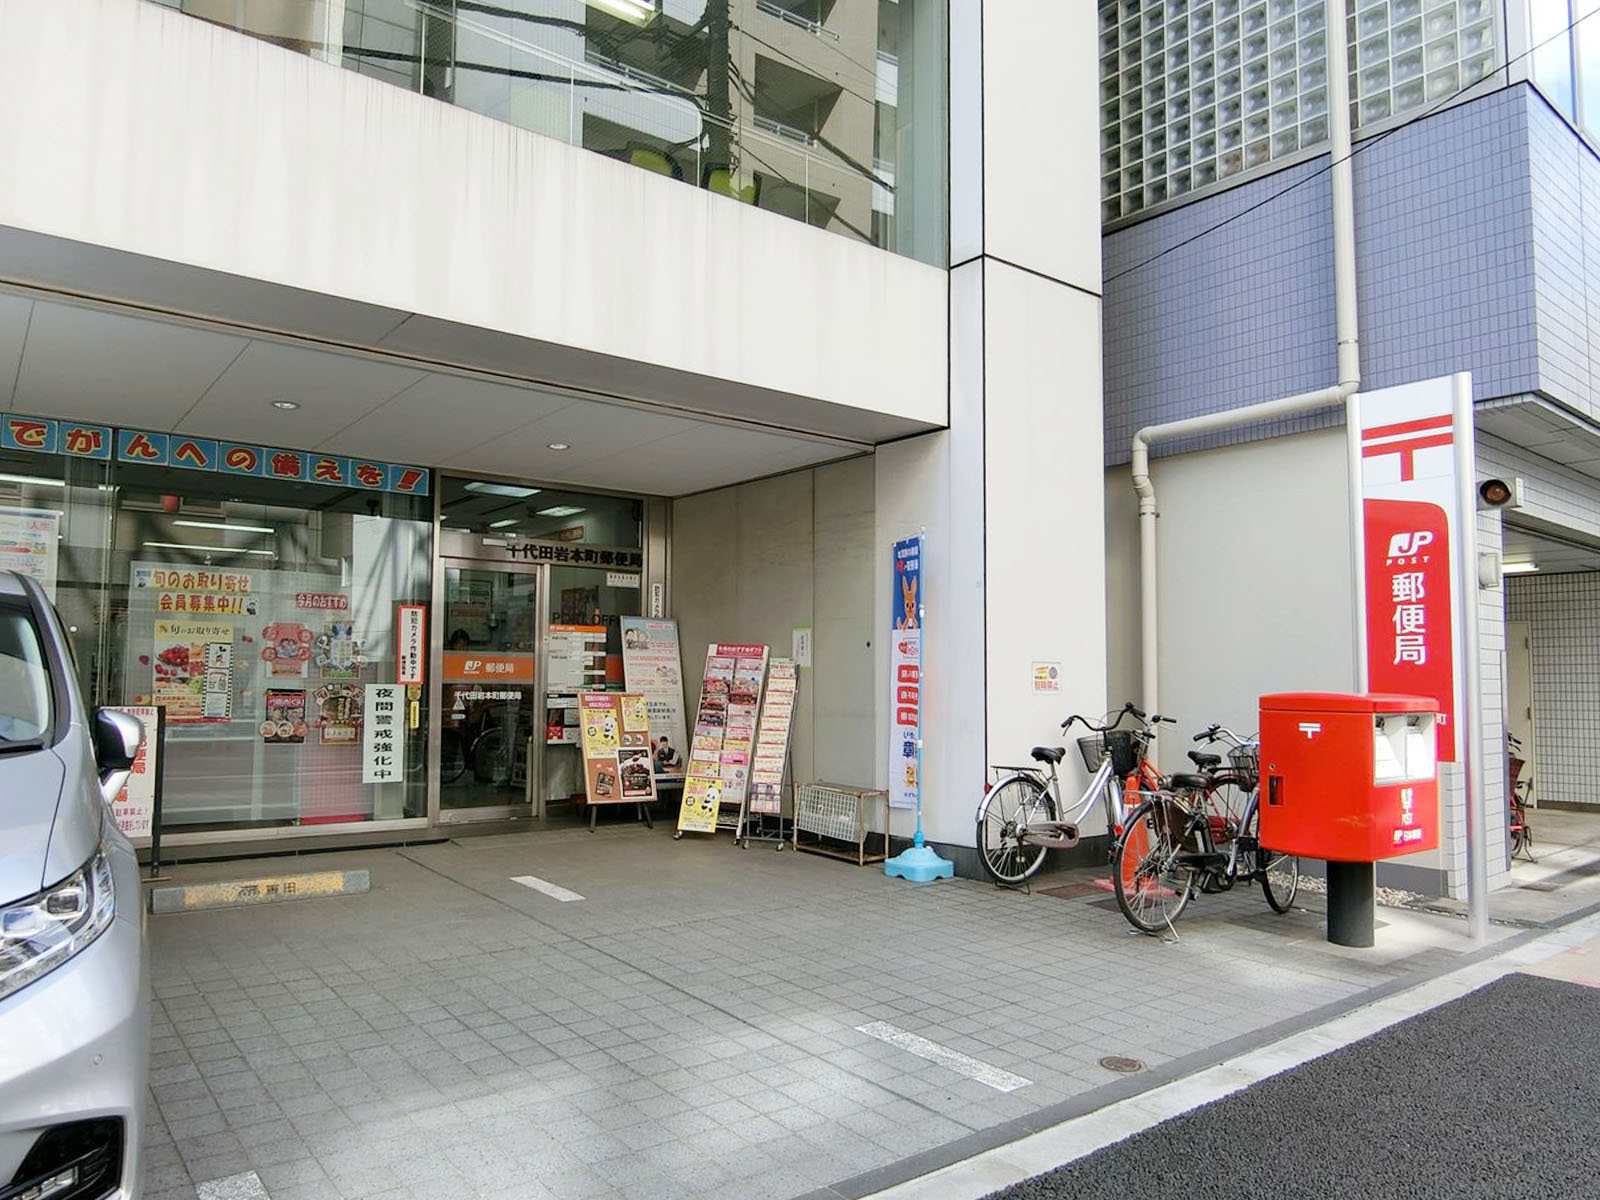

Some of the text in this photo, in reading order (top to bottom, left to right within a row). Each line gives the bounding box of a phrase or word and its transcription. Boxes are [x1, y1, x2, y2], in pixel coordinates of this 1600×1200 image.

[1385, 556, 1430, 566] POST
[153, 570, 250, 593] 旬のお取り寄せ
[297, 592, 348, 610] 今月のおすすめ
[1391, 571, 1426, 666] 郵便局
[410, 611, 419, 680] 防犯カメラ作動中です
[485, 662, 515, 674] 郵便局
[373, 688, 395, 780] 夜間警戒強化中
